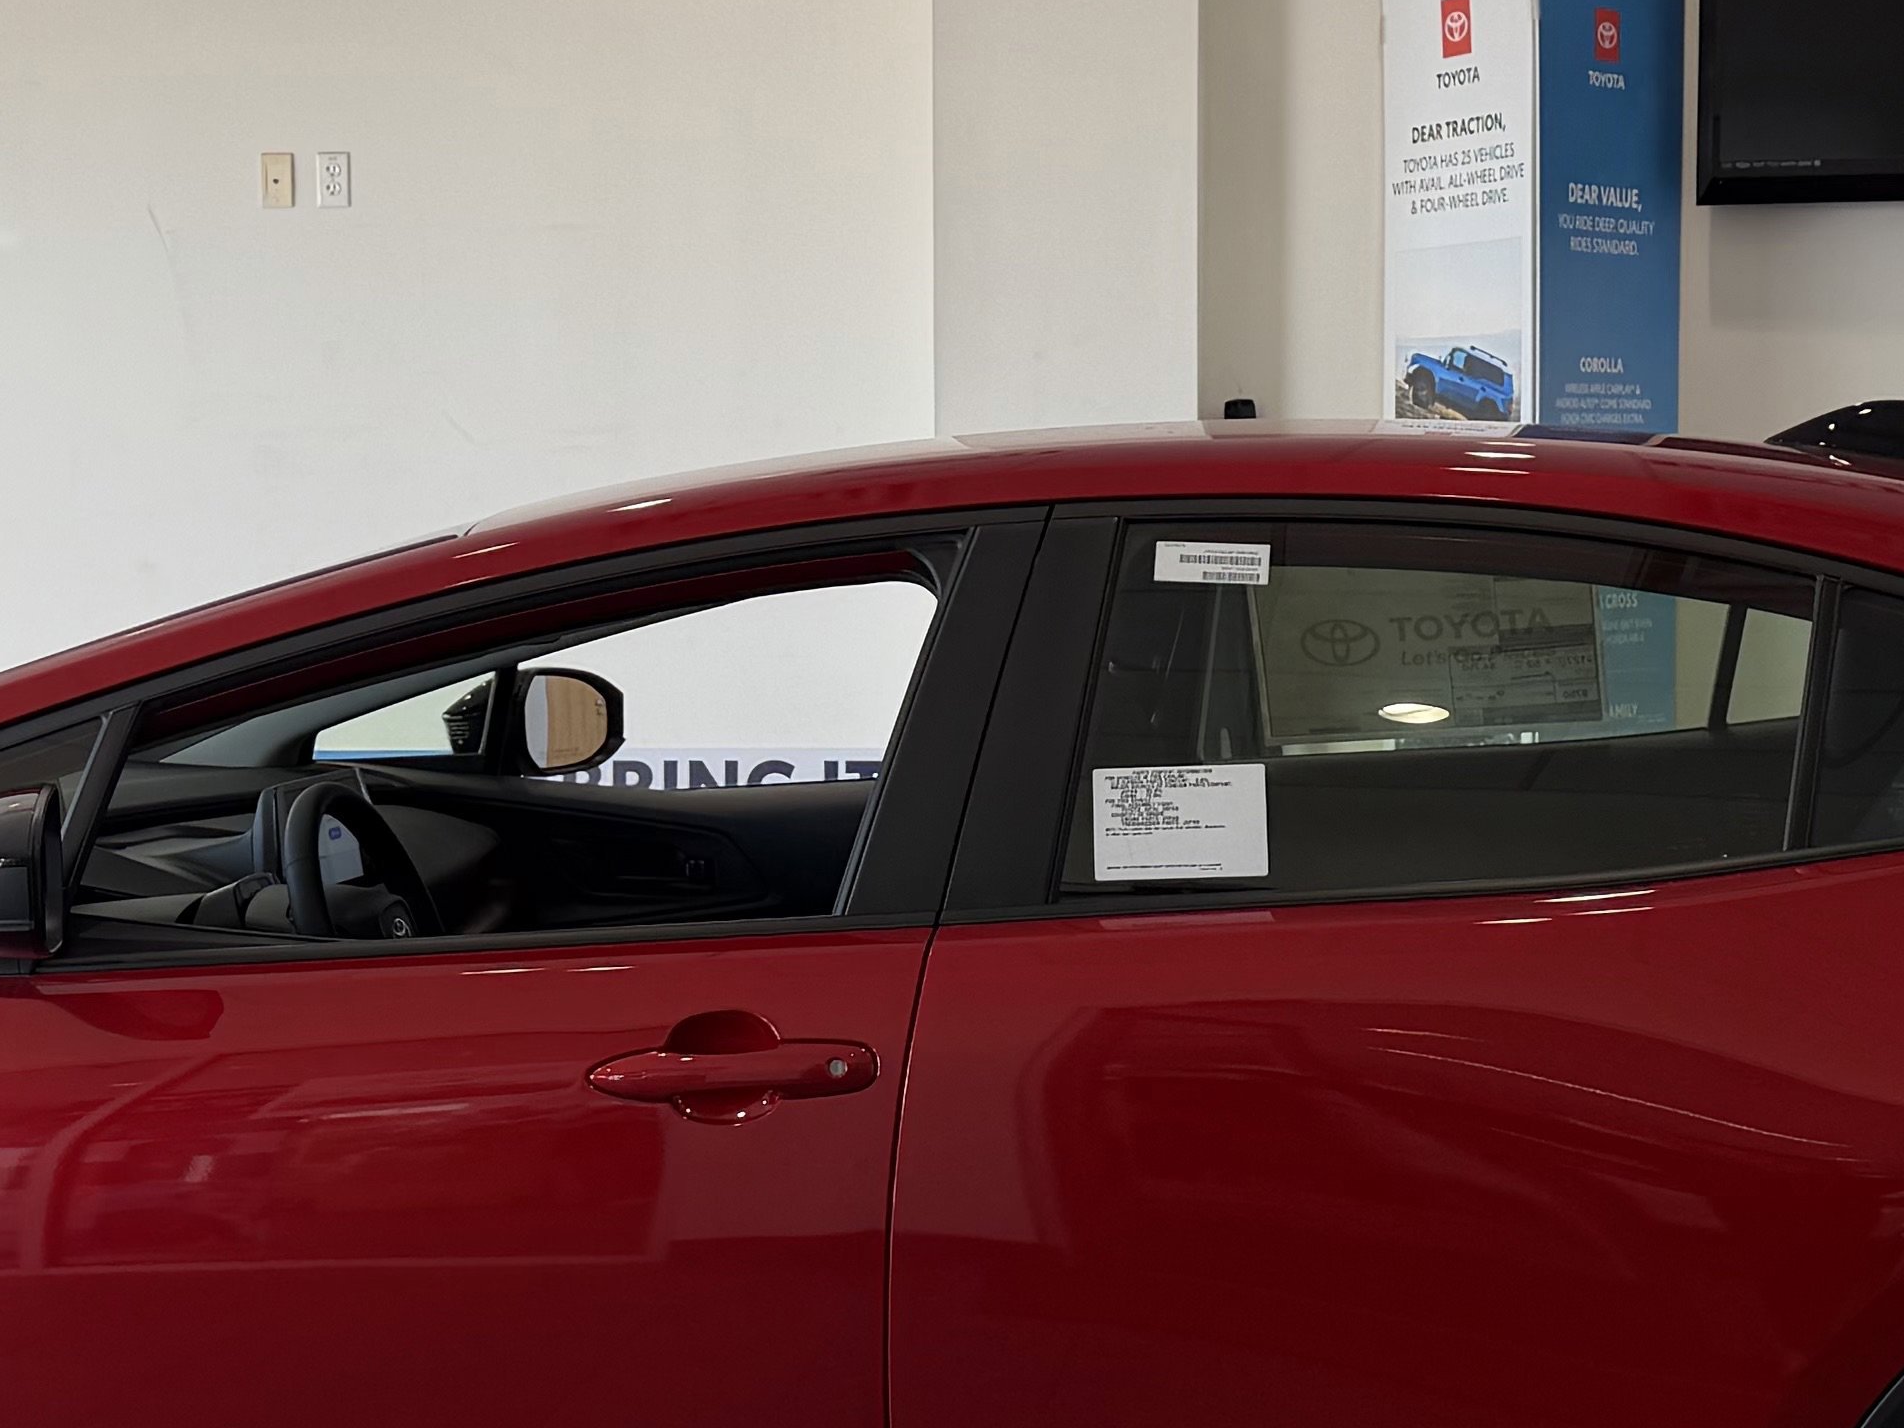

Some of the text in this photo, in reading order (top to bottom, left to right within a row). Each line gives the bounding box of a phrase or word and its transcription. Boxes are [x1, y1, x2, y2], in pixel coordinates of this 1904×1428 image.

[1437, 66, 1480, 89] TOYOTA
[1588, 70, 1625, 90] TOYOTA
[1412, 112, 1506, 144] DEAR TRACTION,
[1403, 155, 1438, 174] TOYOTA
[1441, 151, 1458, 168] HAS
[1392, 180, 1416, 196] WITH
[1448, 168, 1497, 189] ALL-WHEEL
[1500, 162, 1525, 181] DRIVE
[1420, 192, 1479, 214] FOUR-WHEEL
[1568, 182, 1643, 213] DEAR VALUE,
[1579, 356, 1624, 373] COROLLA
[1605, 592, 1638, 609] CROSS
[1389, 607, 1555, 642] TOYOTA
[1401, 649, 1446, 666] Let's
